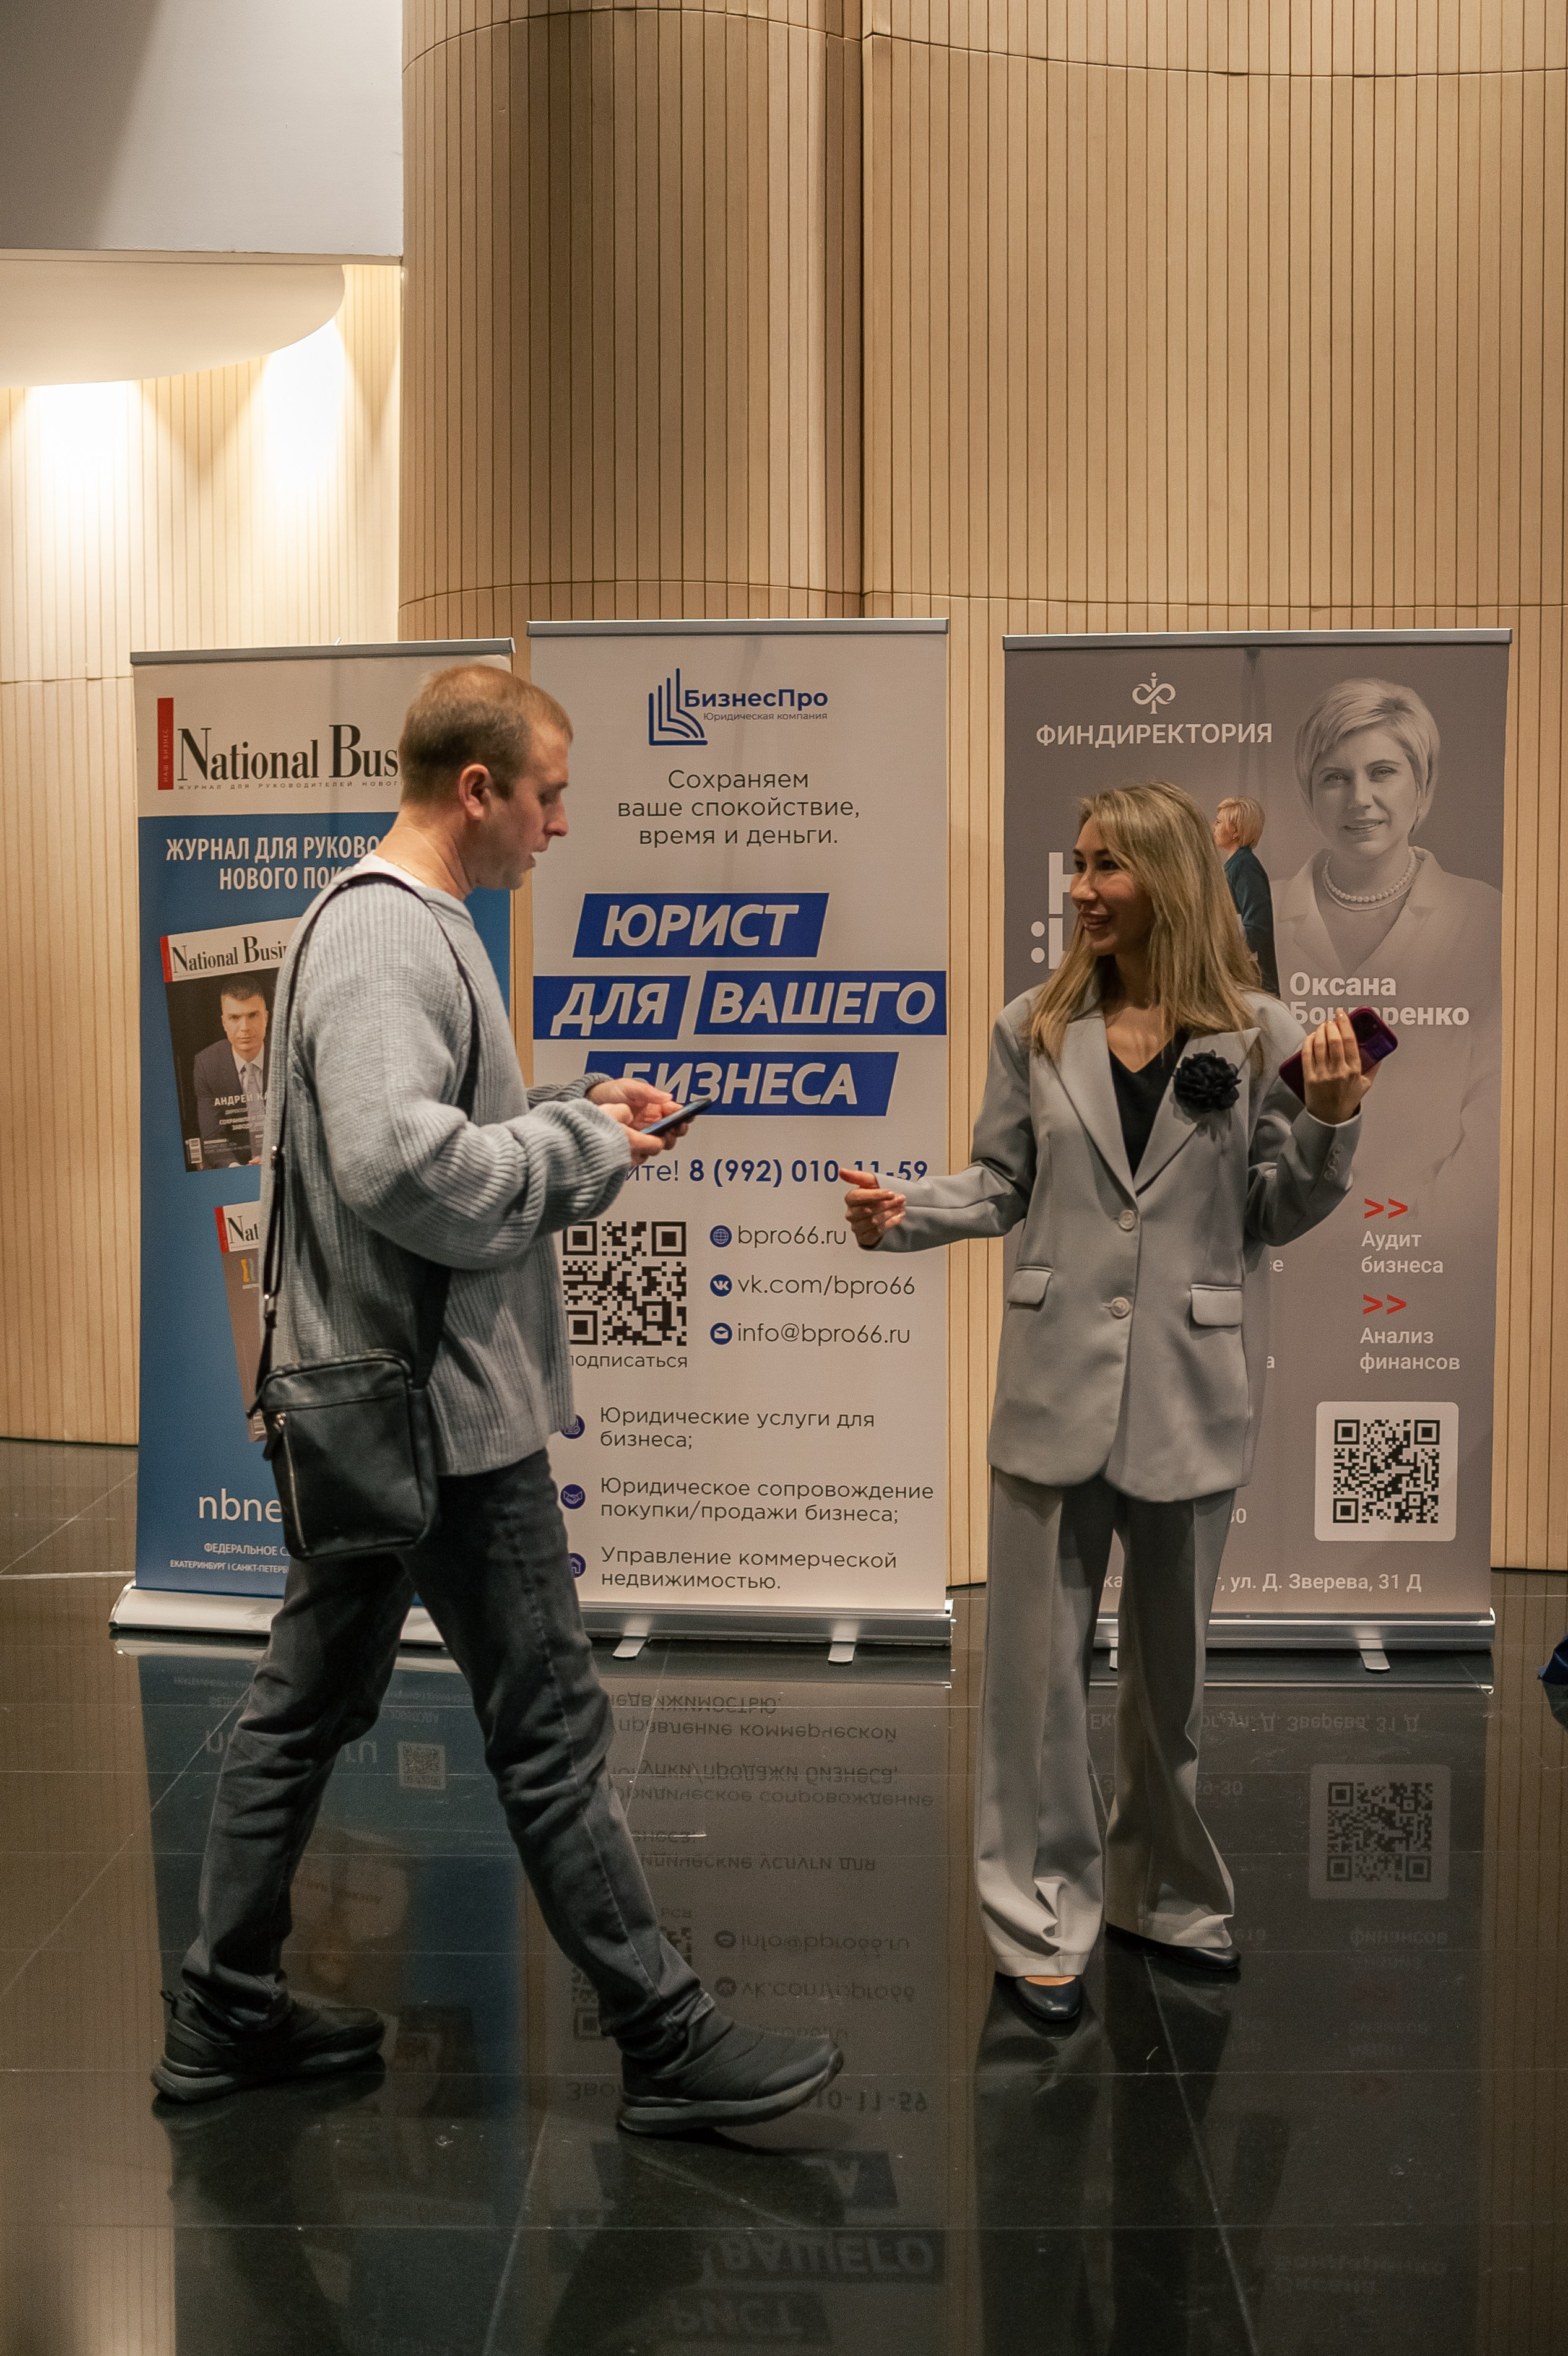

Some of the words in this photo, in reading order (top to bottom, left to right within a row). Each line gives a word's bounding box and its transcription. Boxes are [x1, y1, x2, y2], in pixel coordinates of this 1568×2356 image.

[685, 689, 828, 711] БизнесПро
[703, 712, 774, 722] Юридическая
[1036, 723, 1272, 748] ФИНДИРЕКТОРИЯ
[177, 727, 319, 781] National
[258, 780, 353, 789] РУКОВОДИТЕЛЕЙ
[668, 769, 808, 792] Сохраняем
[618, 802, 683, 817] ваше
[691, 797, 859, 818] спокойствие,
[639, 829, 715, 848] время
[725, 829, 738, 844] и
[746, 829, 838, 847] деньги.
[166, 837, 249, 861] ЖУРНАЛ
[254, 837, 297, 864] ДЛЯ
[220, 867, 298, 890] НОВОГО
[602, 904, 800, 947] ЮРИСТ
[171, 945, 240, 974] National
[1289, 972, 1397, 996] Оксана
[550, 983, 670, 1036] ДЛЯ
[709, 981, 935, 1024] ВАШЕГО
[1289, 1001, 1470, 1026] Боренко
[214, 1091, 253, 1107] АНДРЕЙ
[689, 1159, 704, 1182] 8
[714, 1159, 782, 1188] (992)
[792, 1159, 927, 1183] 01011-59
[738, 1225, 846, 1248] bpro66.ru
[1361, 1230, 1422, 1252] Аудит
[1361, 1255, 1444, 1273] бизнеса
[737, 1275, 915, 1299] vk.com/bpro66
[738, 1323, 910, 1346] info@bpro66.ru
[1359, 1327, 1434, 1344] Анализ
[1359, 1352, 1460, 1374] финансов
[600, 1406, 750, 1426] Юридические
[756, 1413, 829, 1429] услуги
[836, 1414, 874, 1429] для
[600, 1430, 692, 1450] бизнеса;
[601, 1477, 750, 1497] Юридическое
[757, 1484, 933, 1501] сопровождение
[601, 1500, 797, 1522] покупки/продажи
[805, 1504, 898, 1524] бизнеса;
[204, 1543, 278, 1556] ФЕДЕРАЛЬНОЕ
[600, 1546, 732, 1566] Управление
[739, 1552, 896, 1570] коммерческой
[170, 1559, 227, 1570] ЕКАТЕРИНБУРГ
[602, 1573, 782, 1590] недвижимостью.
[1230, 1577, 1257, 1593] ул.
[1262, 1573, 1283, 1592] Д.
[1289, 1573, 1373, 1593] Зверева,
[1379, 1574, 1398, 1590] 31
[1406, 1574, 1422, 1593] Д
